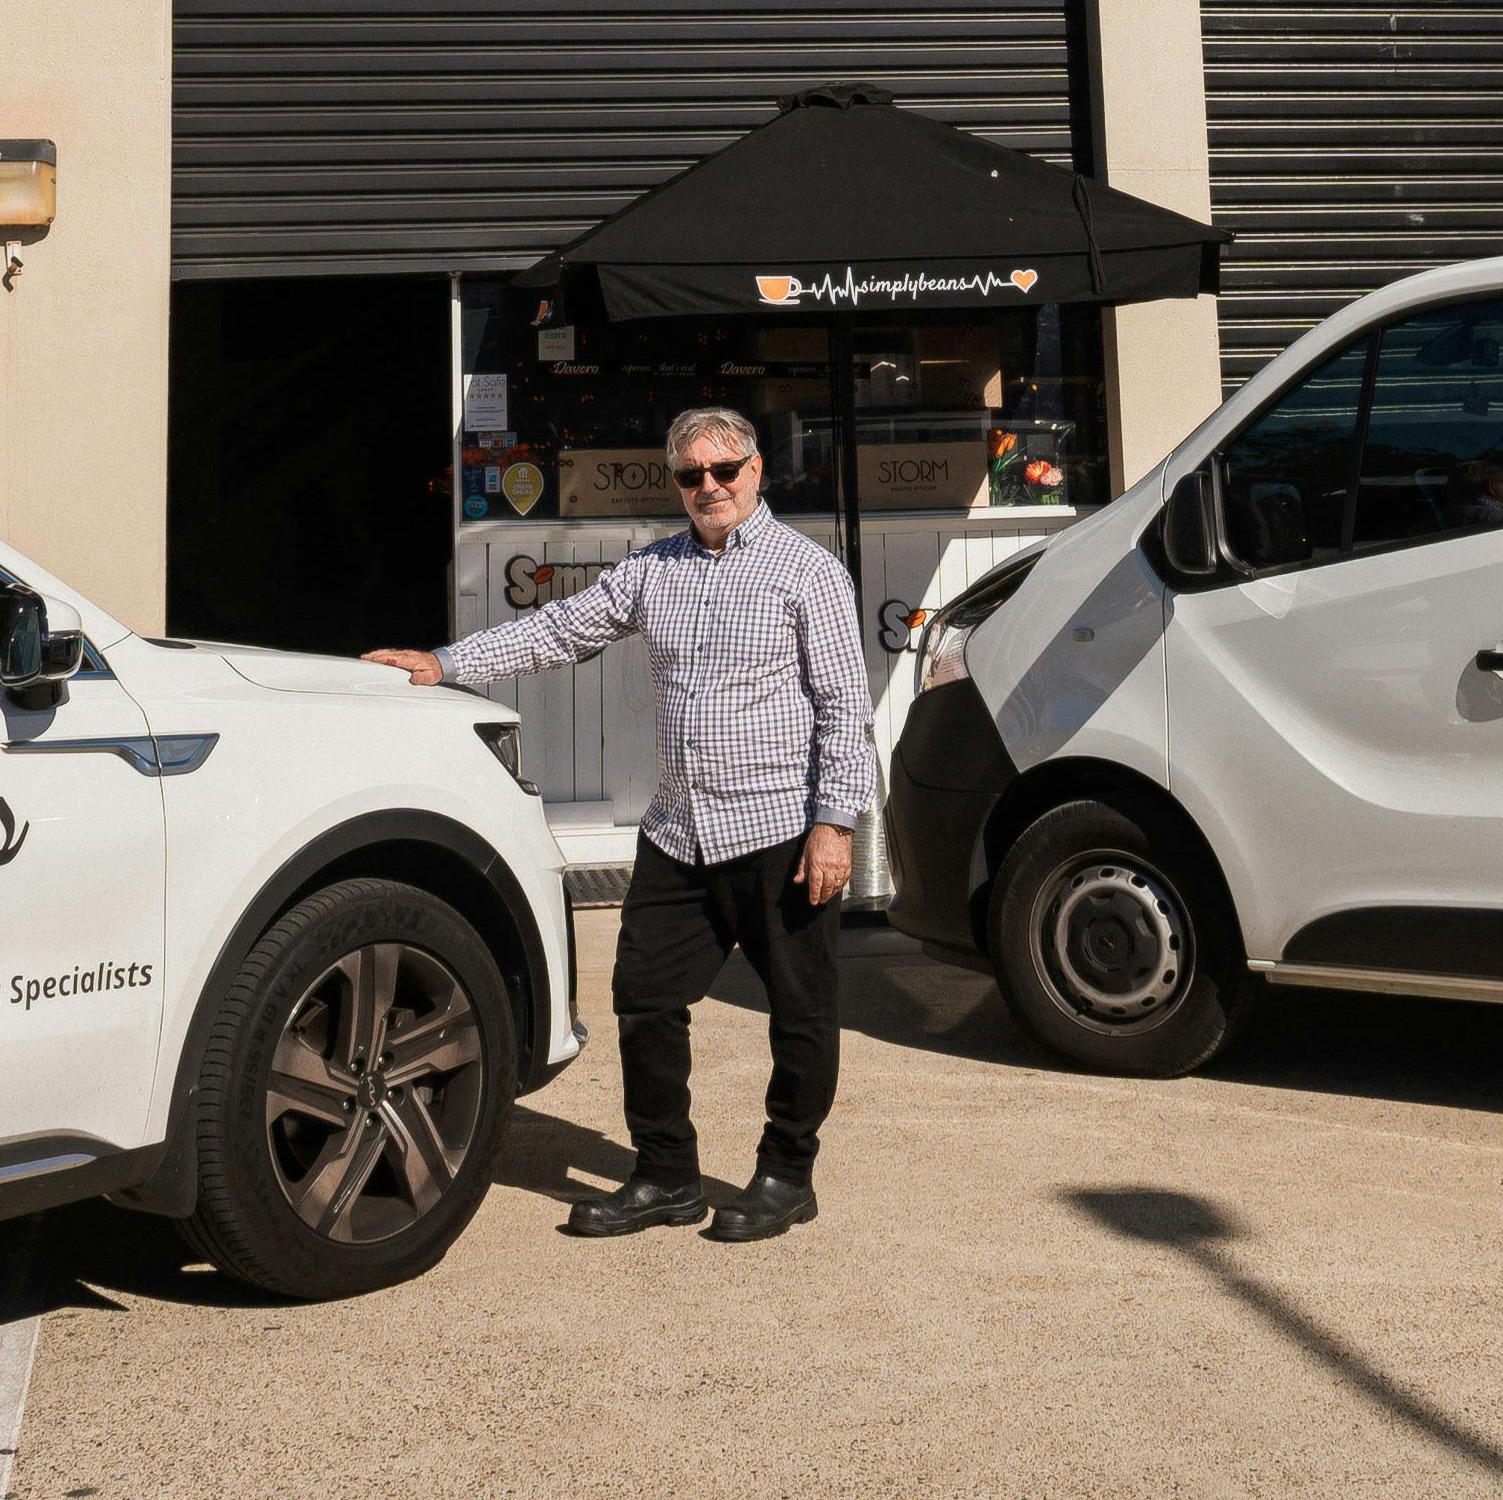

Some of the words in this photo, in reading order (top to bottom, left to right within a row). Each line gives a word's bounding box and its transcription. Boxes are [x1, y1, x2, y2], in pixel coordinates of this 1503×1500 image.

[861, 272, 968, 300] simplybeans
[878, 459, 949, 483] STORM
[9, 960, 154, 1011] Specialists
